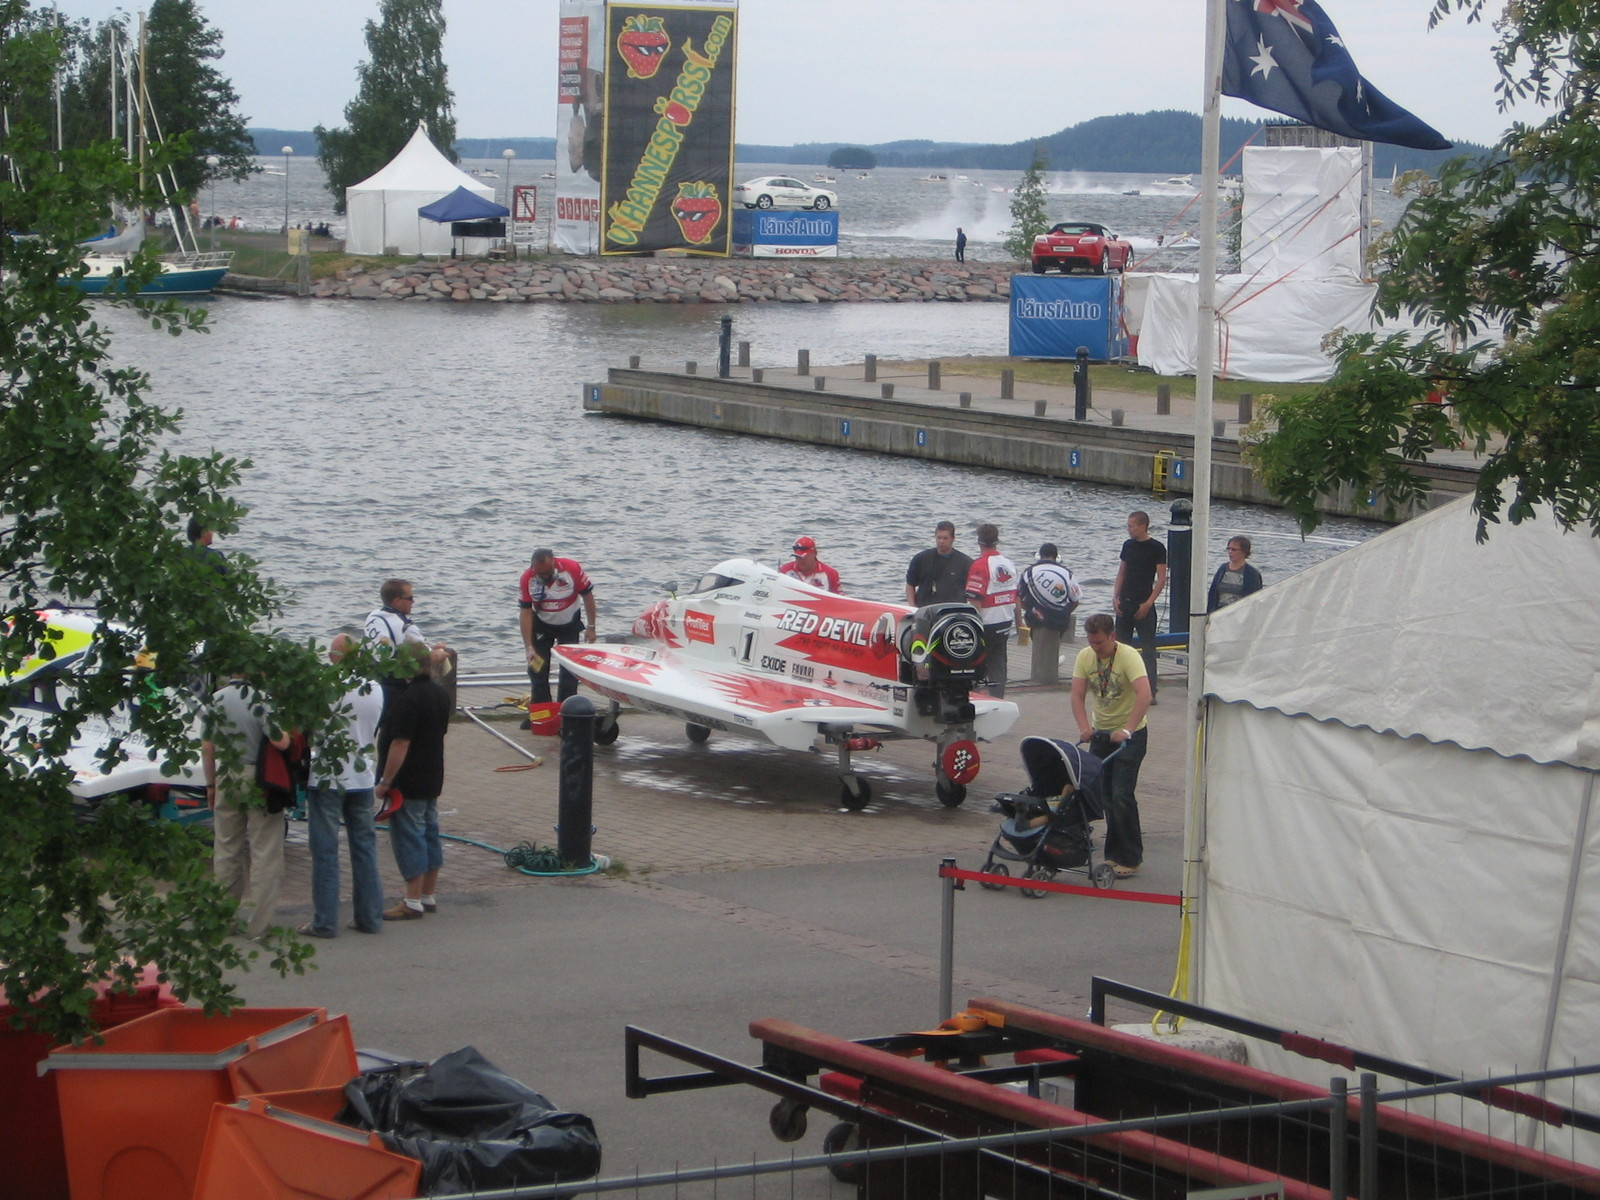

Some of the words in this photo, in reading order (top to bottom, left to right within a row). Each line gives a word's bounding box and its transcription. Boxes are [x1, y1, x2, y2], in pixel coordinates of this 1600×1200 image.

[760, 217, 833, 237] LänsiAuto
[1016, 298, 1101, 320] LänsiAuto
[1071, 453, 1077, 465] 5
[1175, 463, 1181, 476] 4
[777, 609, 819, 635] RED
[817, 616, 867, 647] DEVIL
[742, 631, 755, 661] 1
[760, 655, 787, 674] EXIDE
[791, 663, 815, 678] FAVARI
